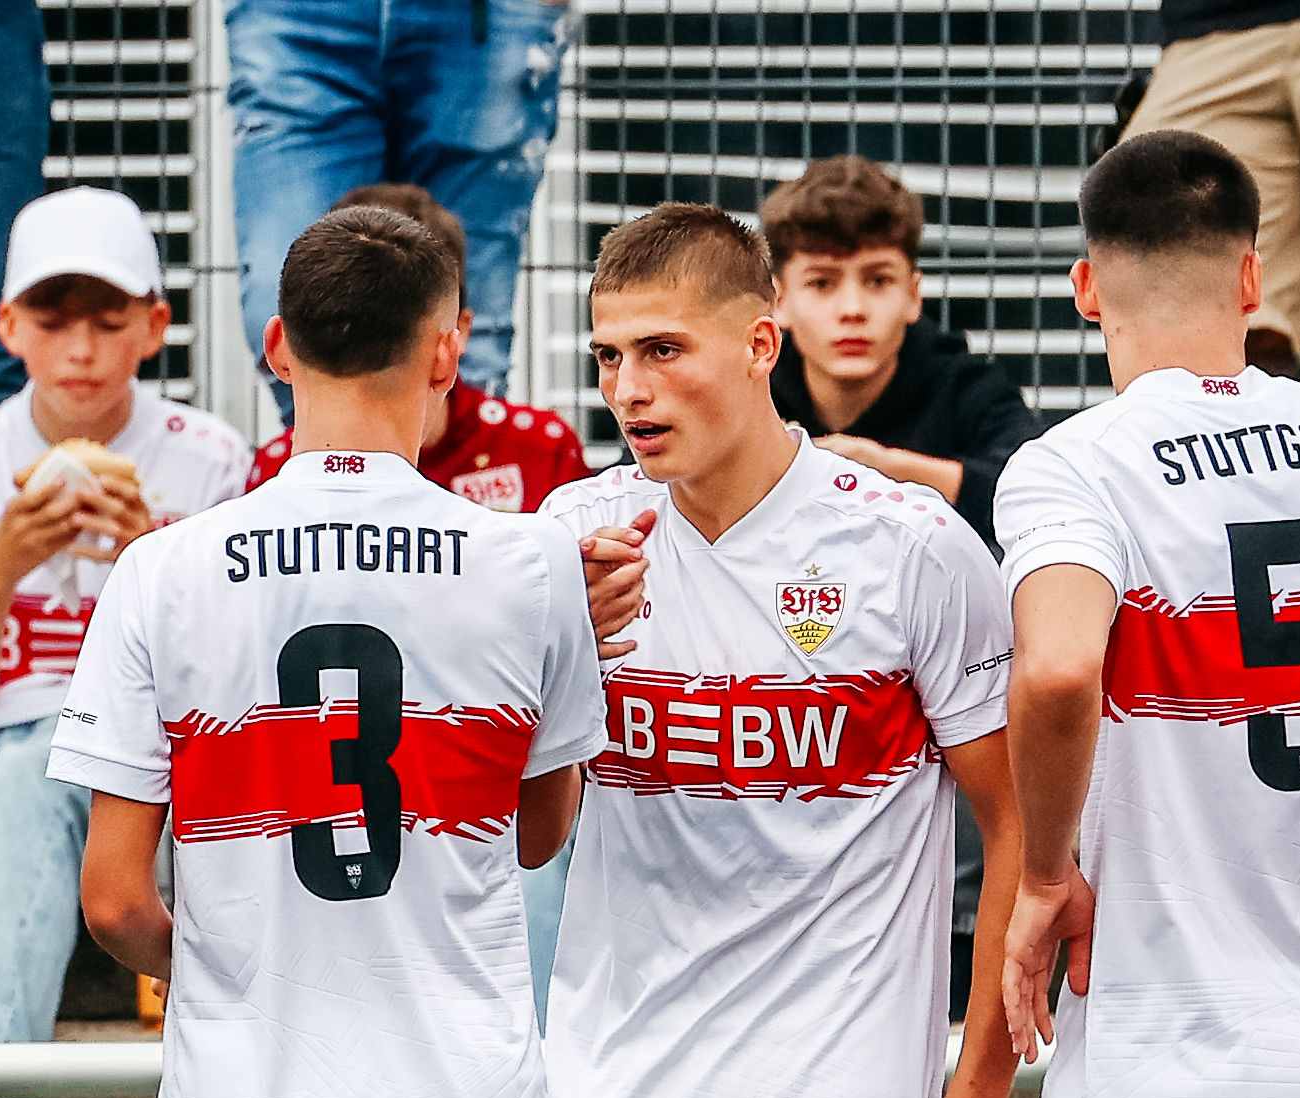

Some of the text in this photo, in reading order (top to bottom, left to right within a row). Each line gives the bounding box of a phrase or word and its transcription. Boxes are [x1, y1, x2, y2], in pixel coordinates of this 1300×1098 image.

[225, 522, 468, 582] STUTTGART
[780, 586, 842, 616] VfB
[277, 623, 404, 901] 3
